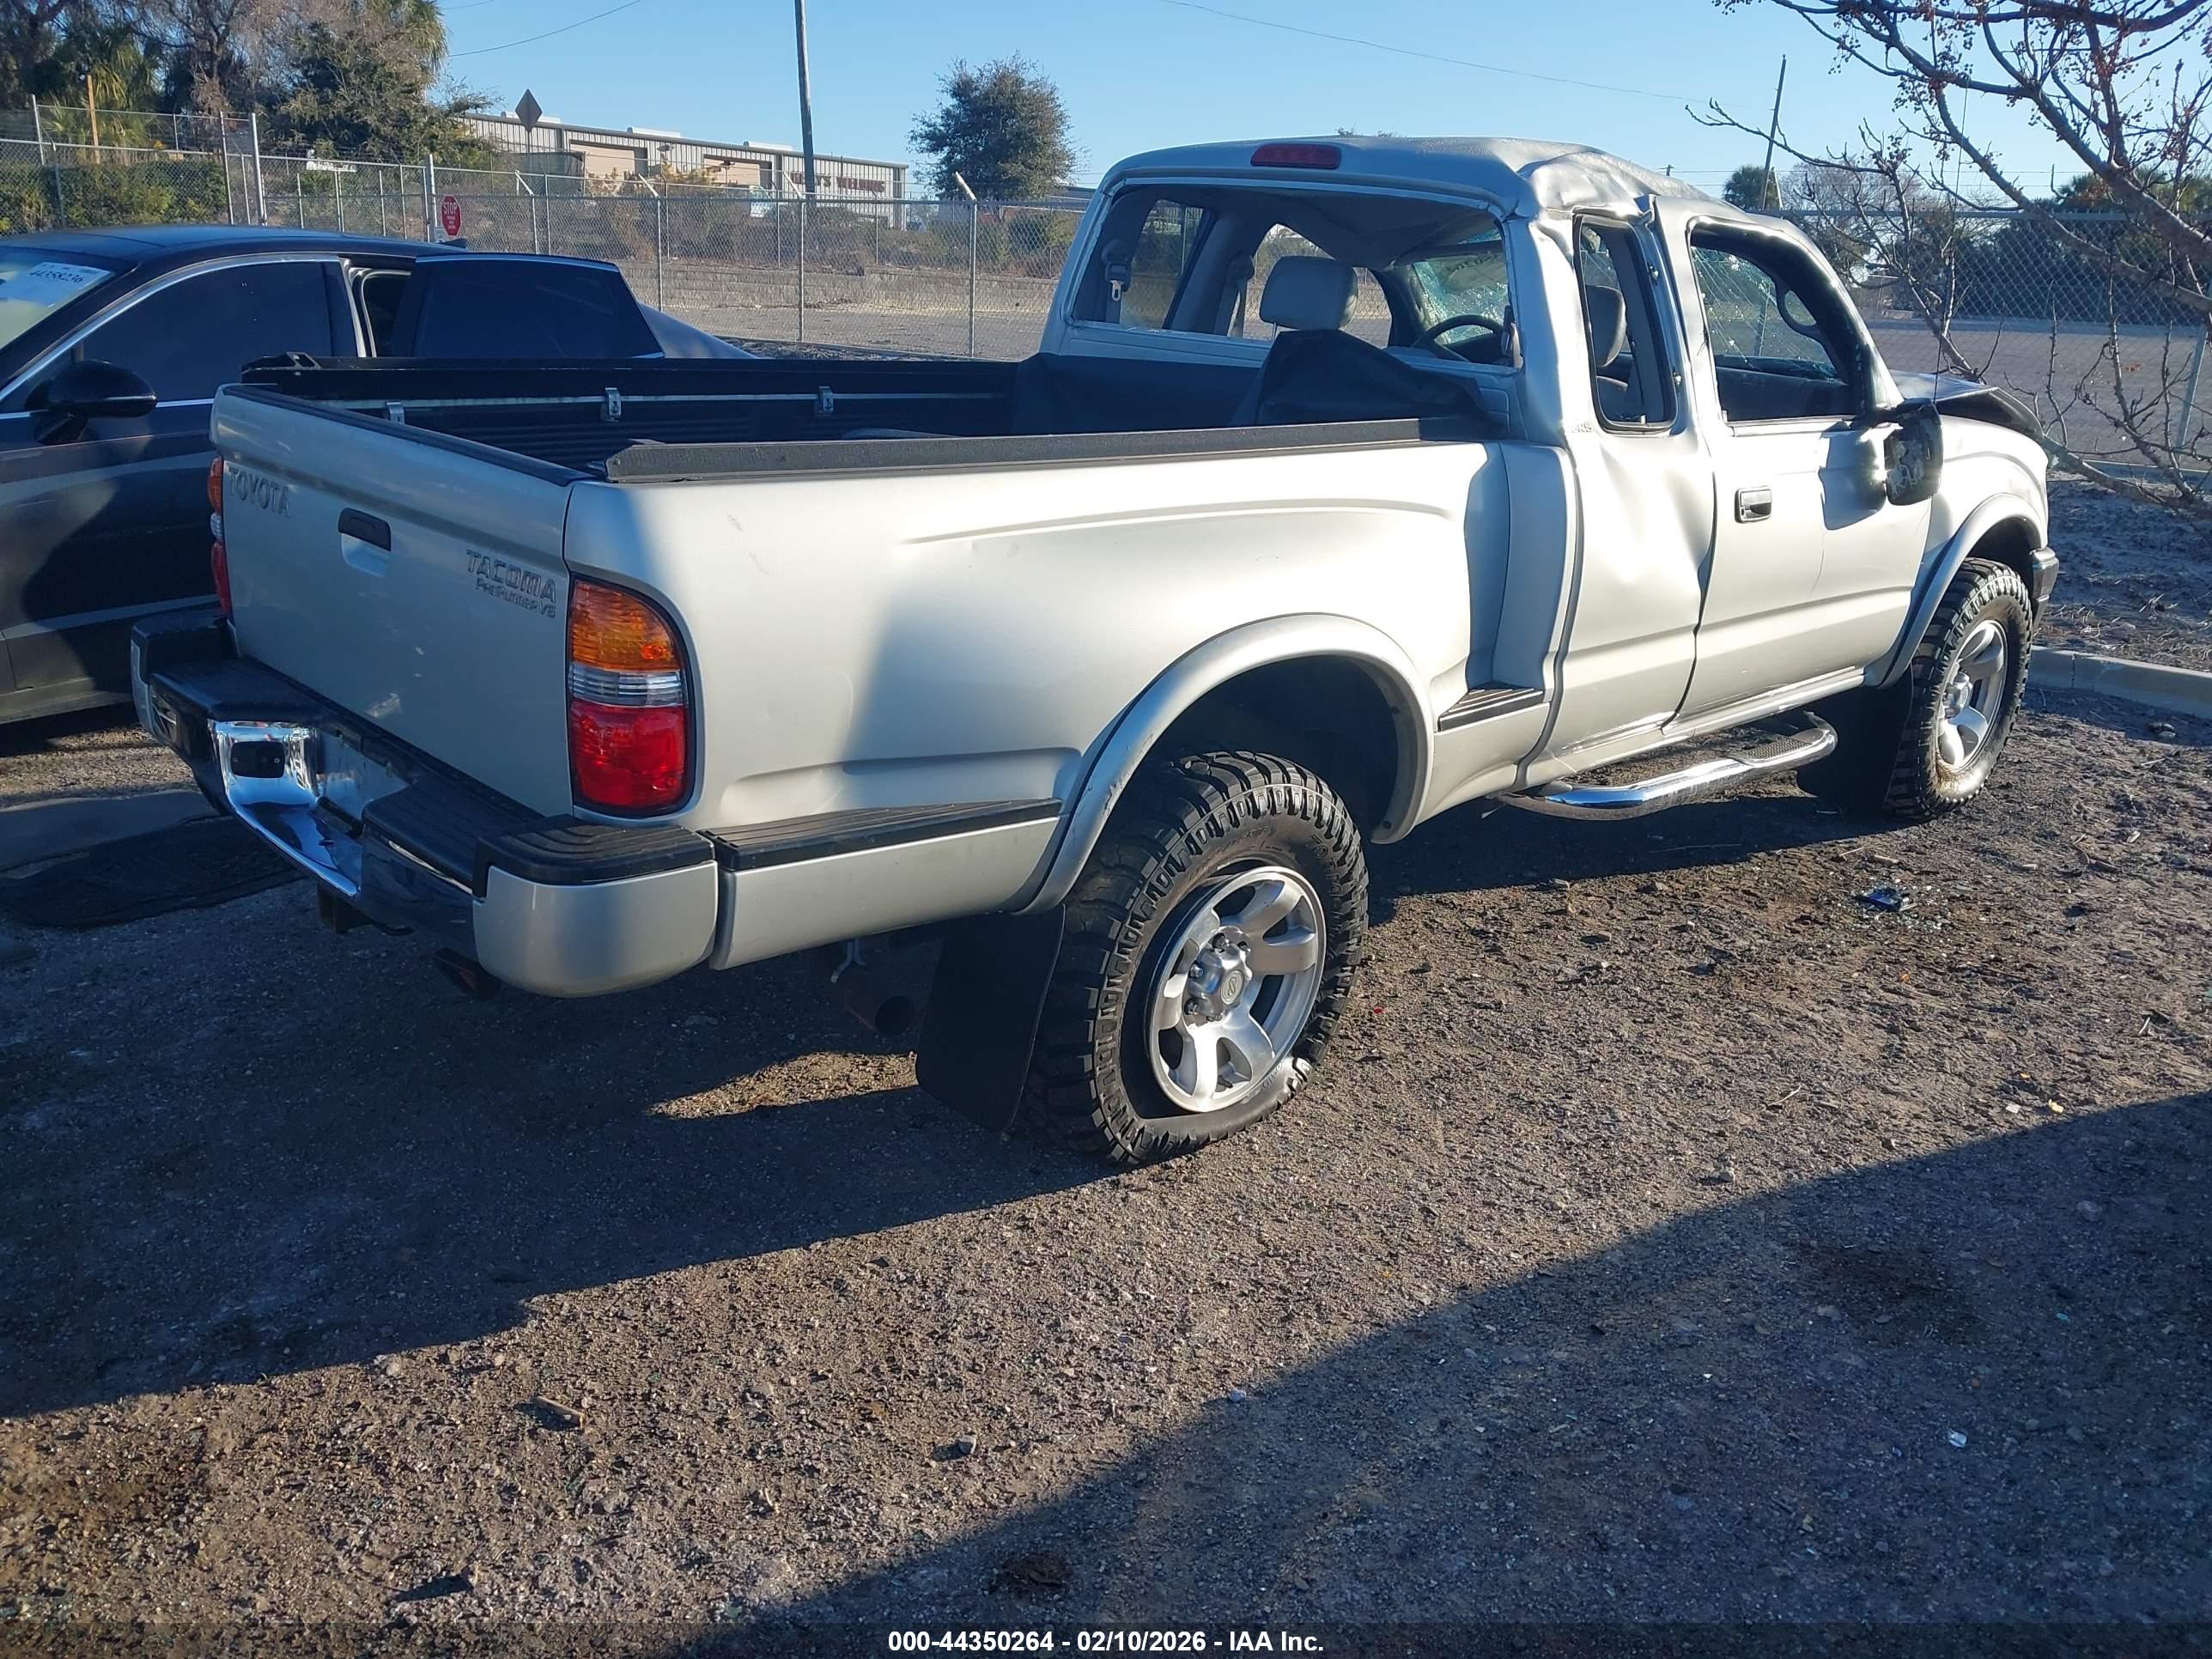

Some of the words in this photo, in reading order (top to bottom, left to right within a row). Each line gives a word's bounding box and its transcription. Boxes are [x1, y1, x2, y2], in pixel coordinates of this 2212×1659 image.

[443, 201, 458, 215] STOP
[228, 466, 290, 519] TOYOTA
[466, 549, 556, 605] TACOMA
